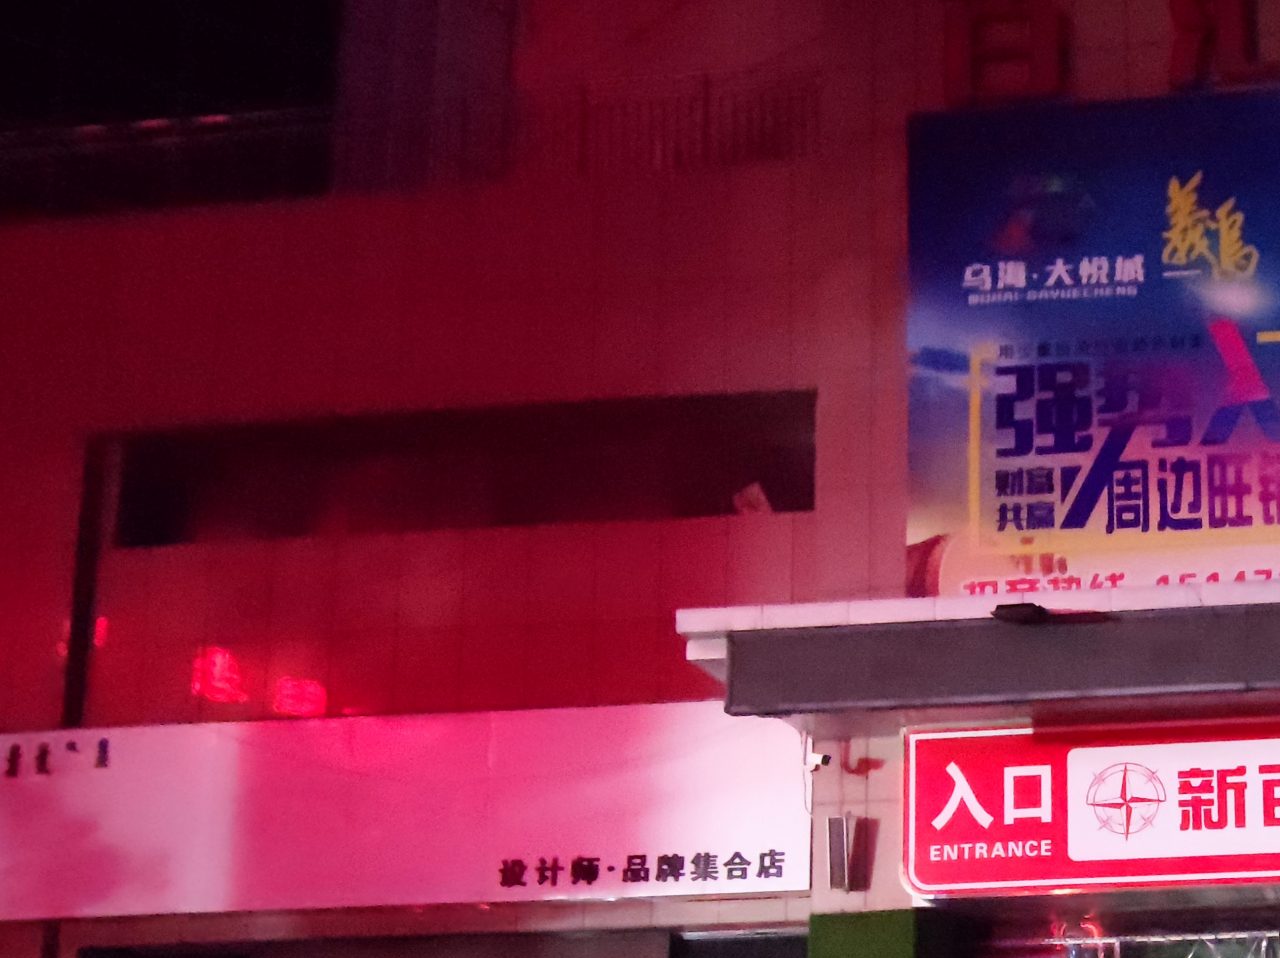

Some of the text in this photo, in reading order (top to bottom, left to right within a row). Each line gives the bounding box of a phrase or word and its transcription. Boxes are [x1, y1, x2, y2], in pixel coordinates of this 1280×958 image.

[962, 253, 1146, 293] 乌海·大悦城
[931, 761, 1053, 832] 入口
[498, 849, 786, 888] 设计师·品牌集合店
[929, 839, 1053, 862] ENTRANCE
